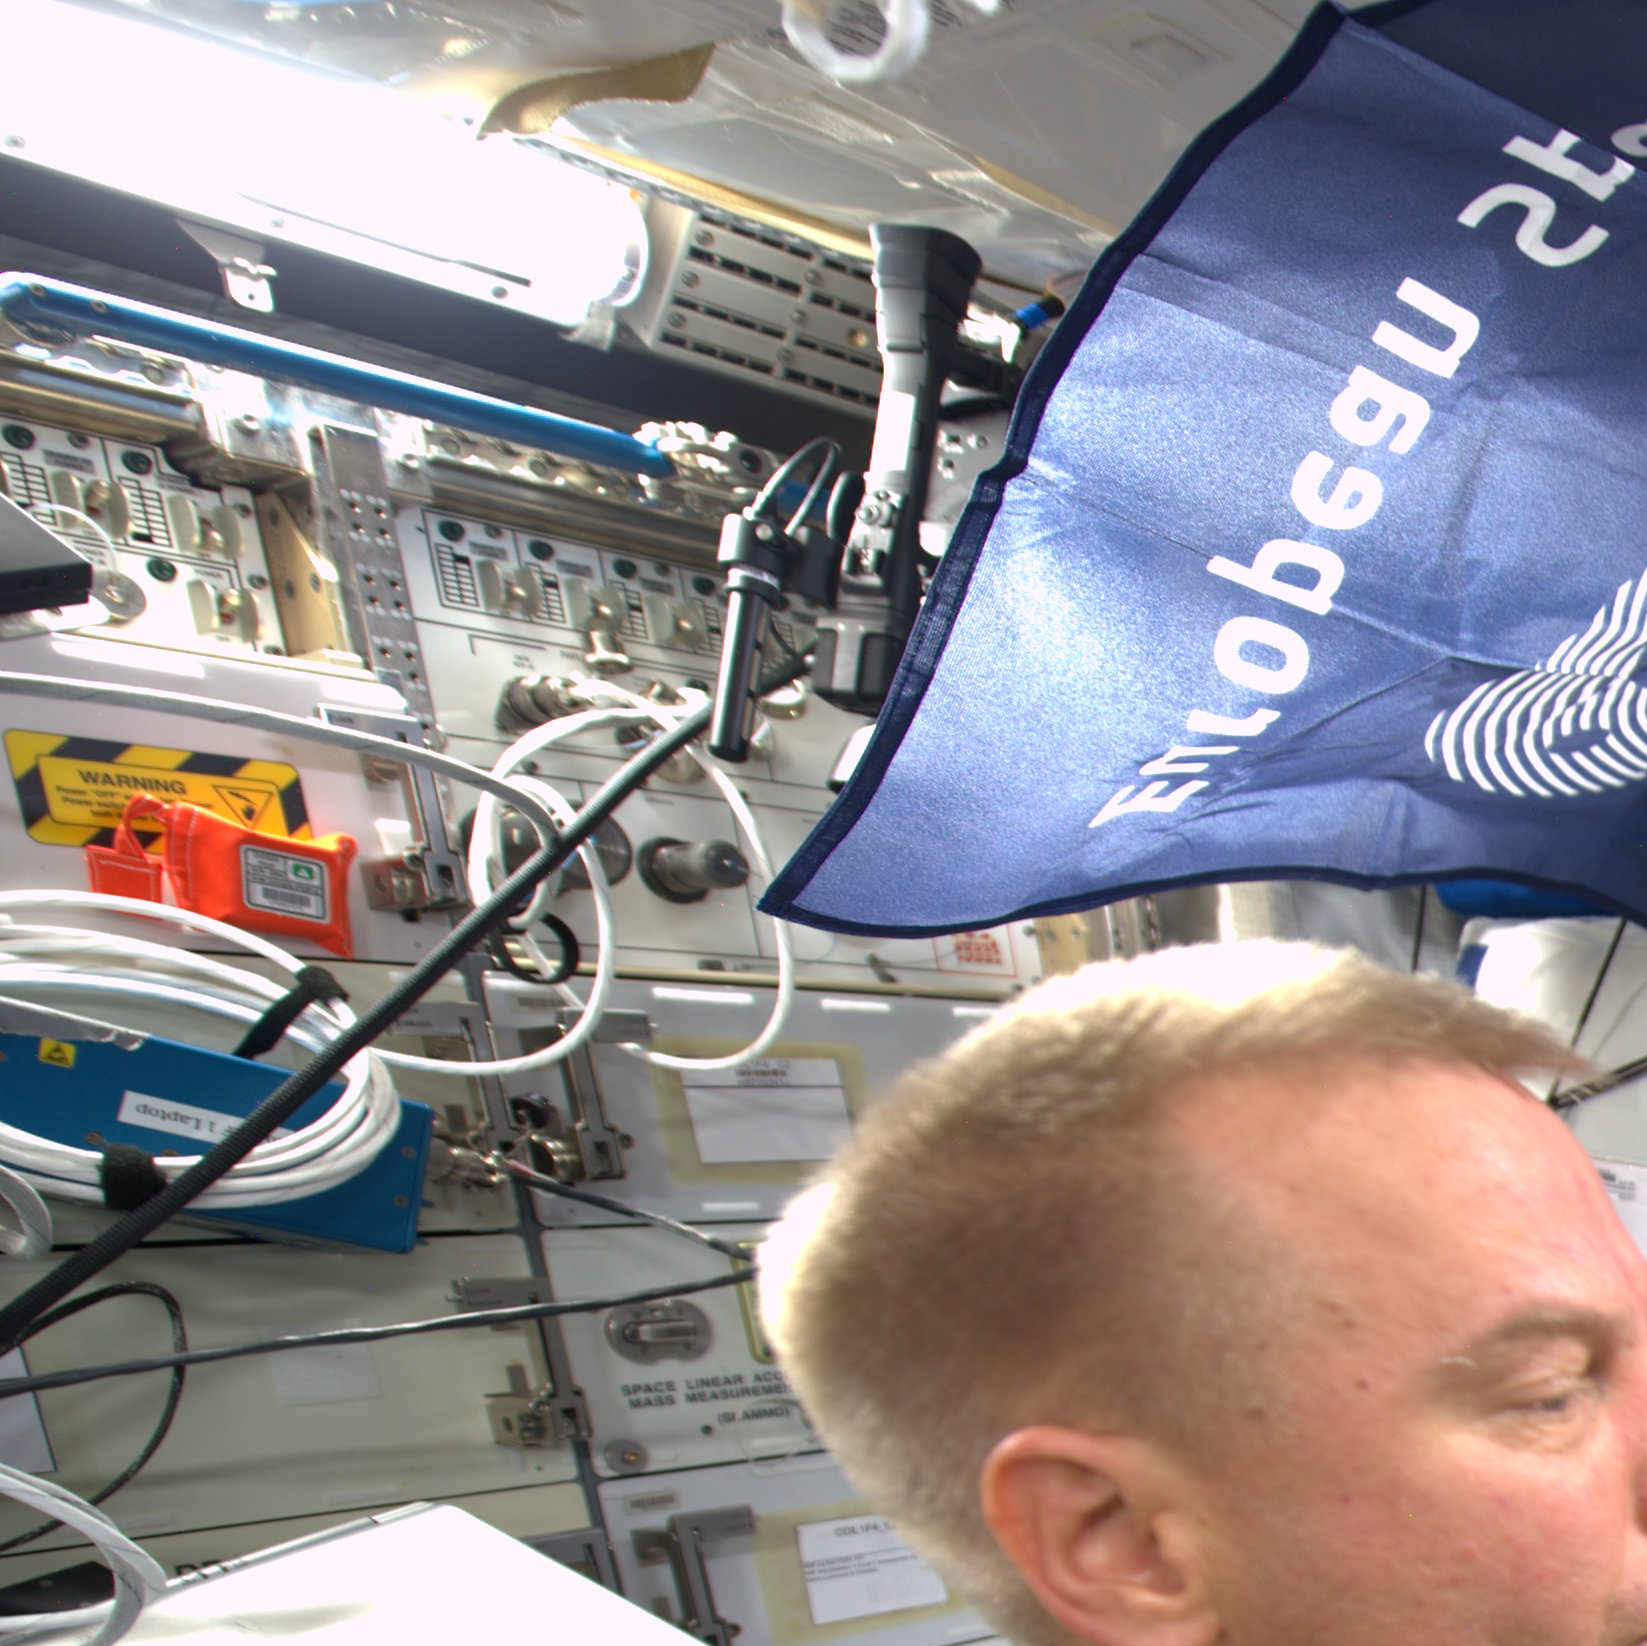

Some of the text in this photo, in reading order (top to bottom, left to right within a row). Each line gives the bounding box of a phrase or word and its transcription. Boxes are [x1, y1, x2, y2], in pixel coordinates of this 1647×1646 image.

[79, 770, 187, 795] WARNING
[135, 1103, 200, 1129] Laptop
[621, 1381, 676, 1396] SPACE
[686, 1374, 744, 1390] LINEAR
[629, 1395, 675, 1409] MASS
